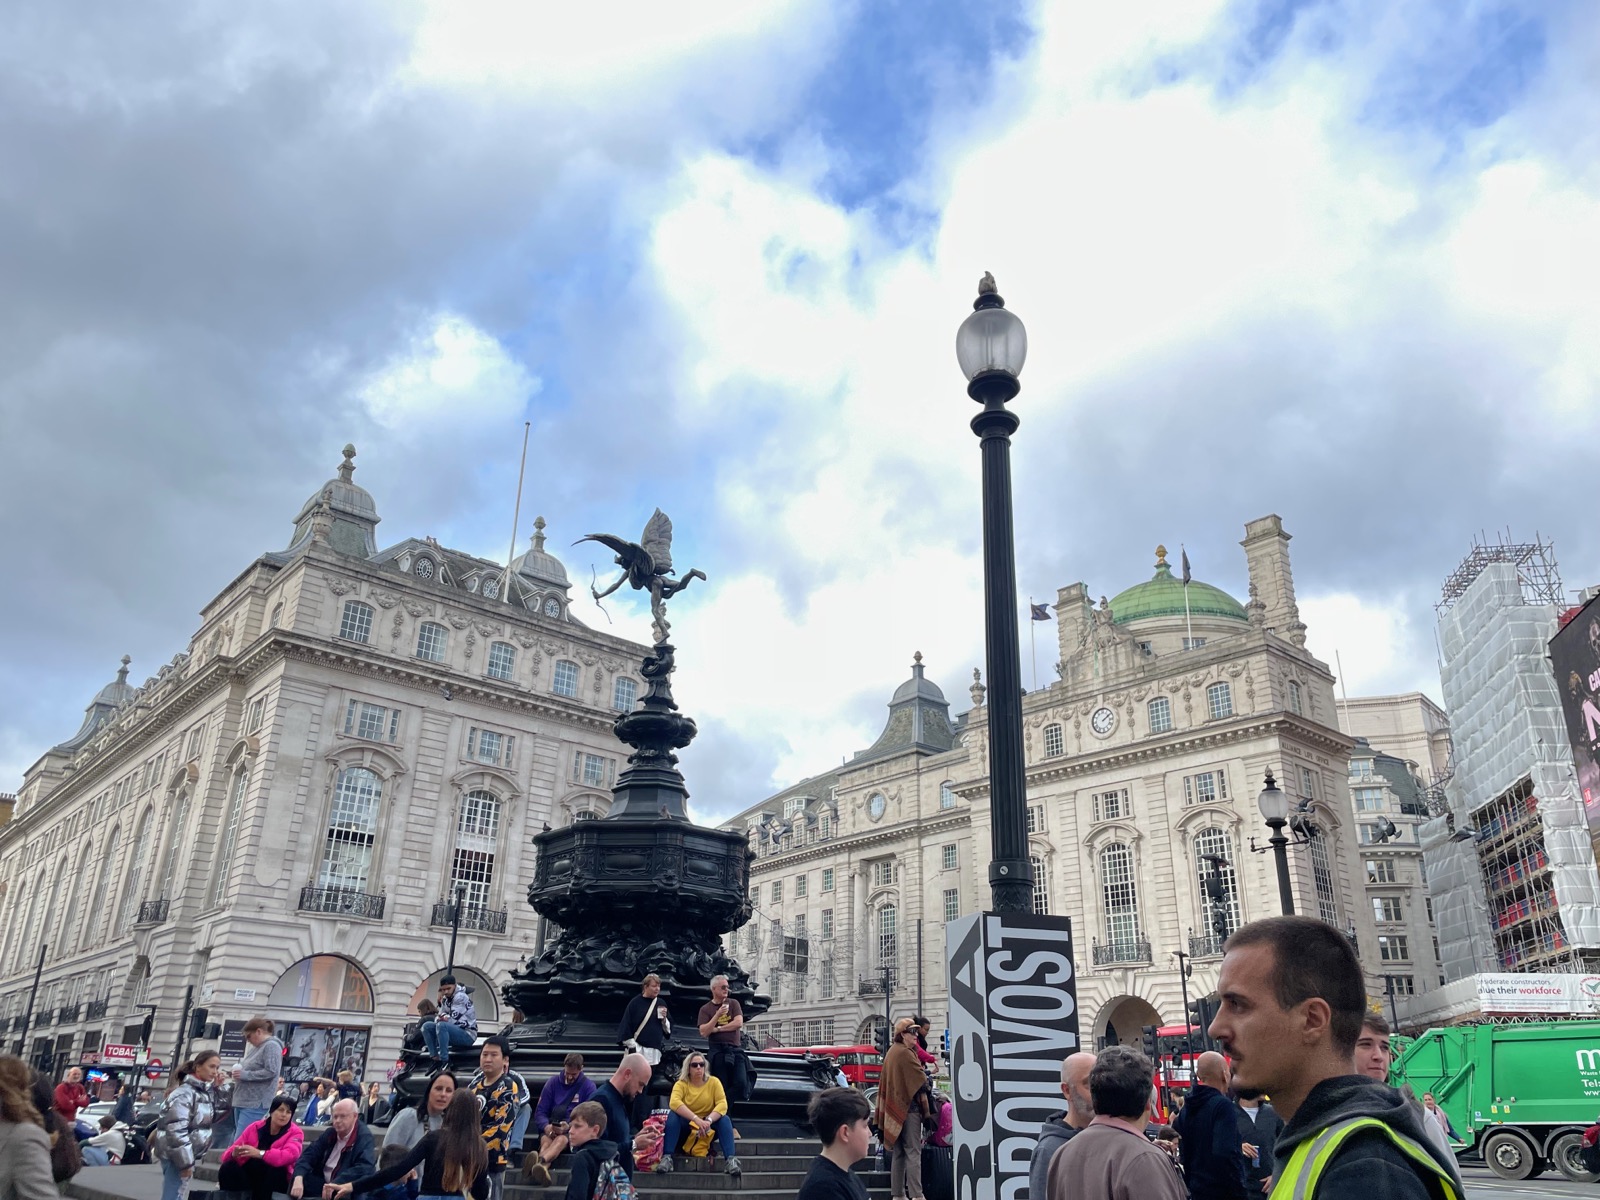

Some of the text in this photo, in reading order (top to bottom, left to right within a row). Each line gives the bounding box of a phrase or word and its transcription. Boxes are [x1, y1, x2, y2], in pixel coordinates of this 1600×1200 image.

[987, 916, 1077, 1200] OUVOST
[1497, 985, 1517, 994] their
[1519, 986, 1562, 995] workforce
